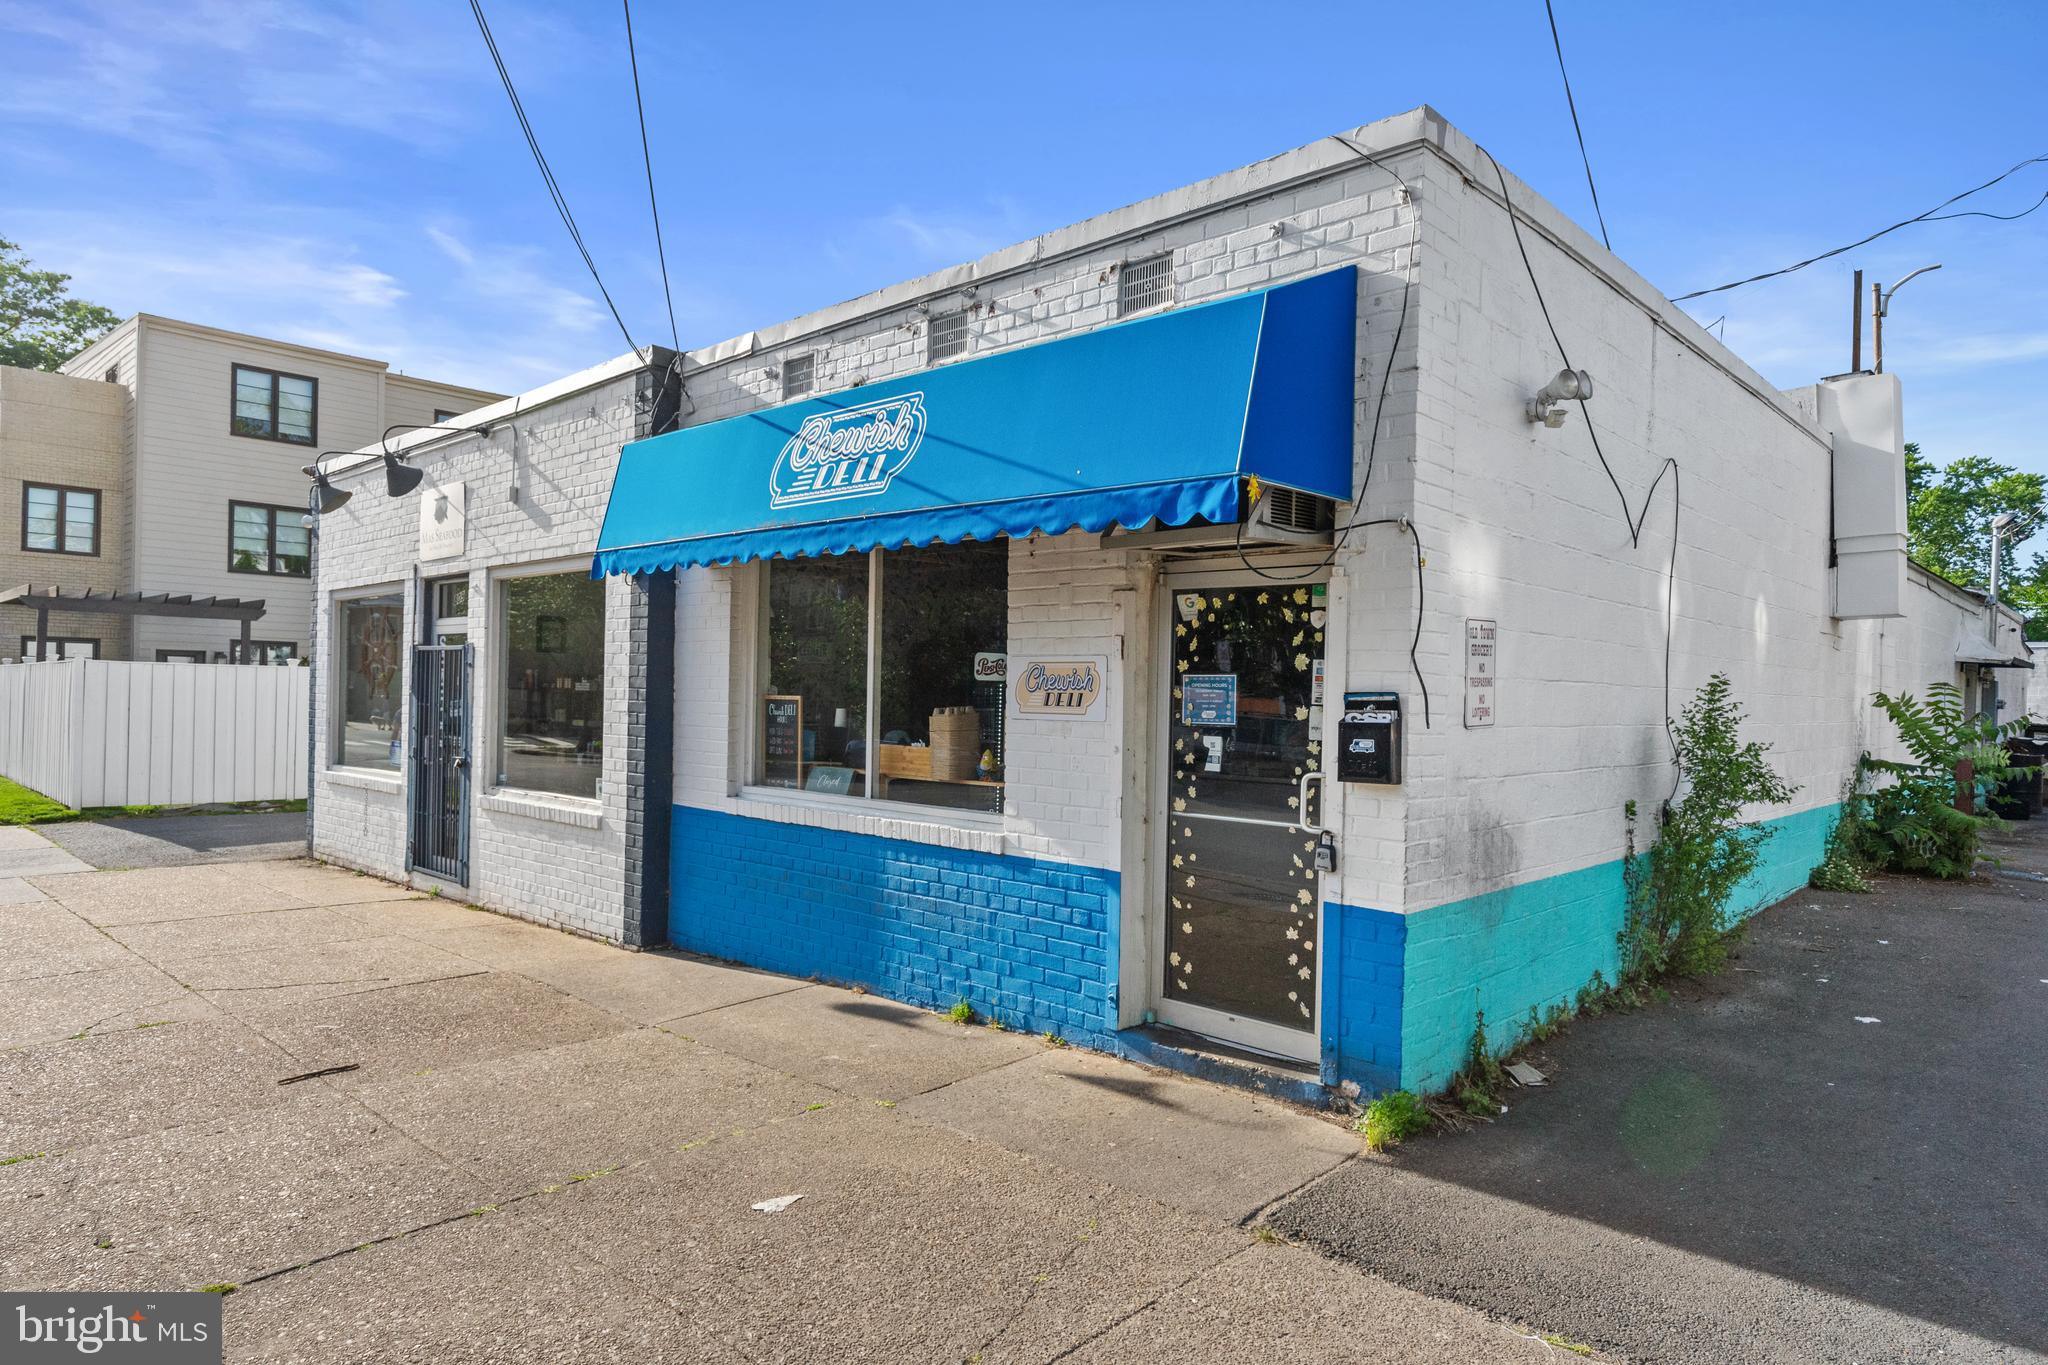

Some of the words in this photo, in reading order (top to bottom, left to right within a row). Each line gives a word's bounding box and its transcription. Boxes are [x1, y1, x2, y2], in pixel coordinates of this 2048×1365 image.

[791, 402, 914, 471] Chewish
[812, 454, 887, 490] DELI
[1479, 663, 1486, 673] NO
[1025, 663, 1094, 692] Chewish
[1469, 677, 1493, 688] TRESPASSING
[1043, 692, 1084, 707] DELI
[1479, 694, 1486, 704] NO
[1472, 707, 1490, 718] LOITERING
